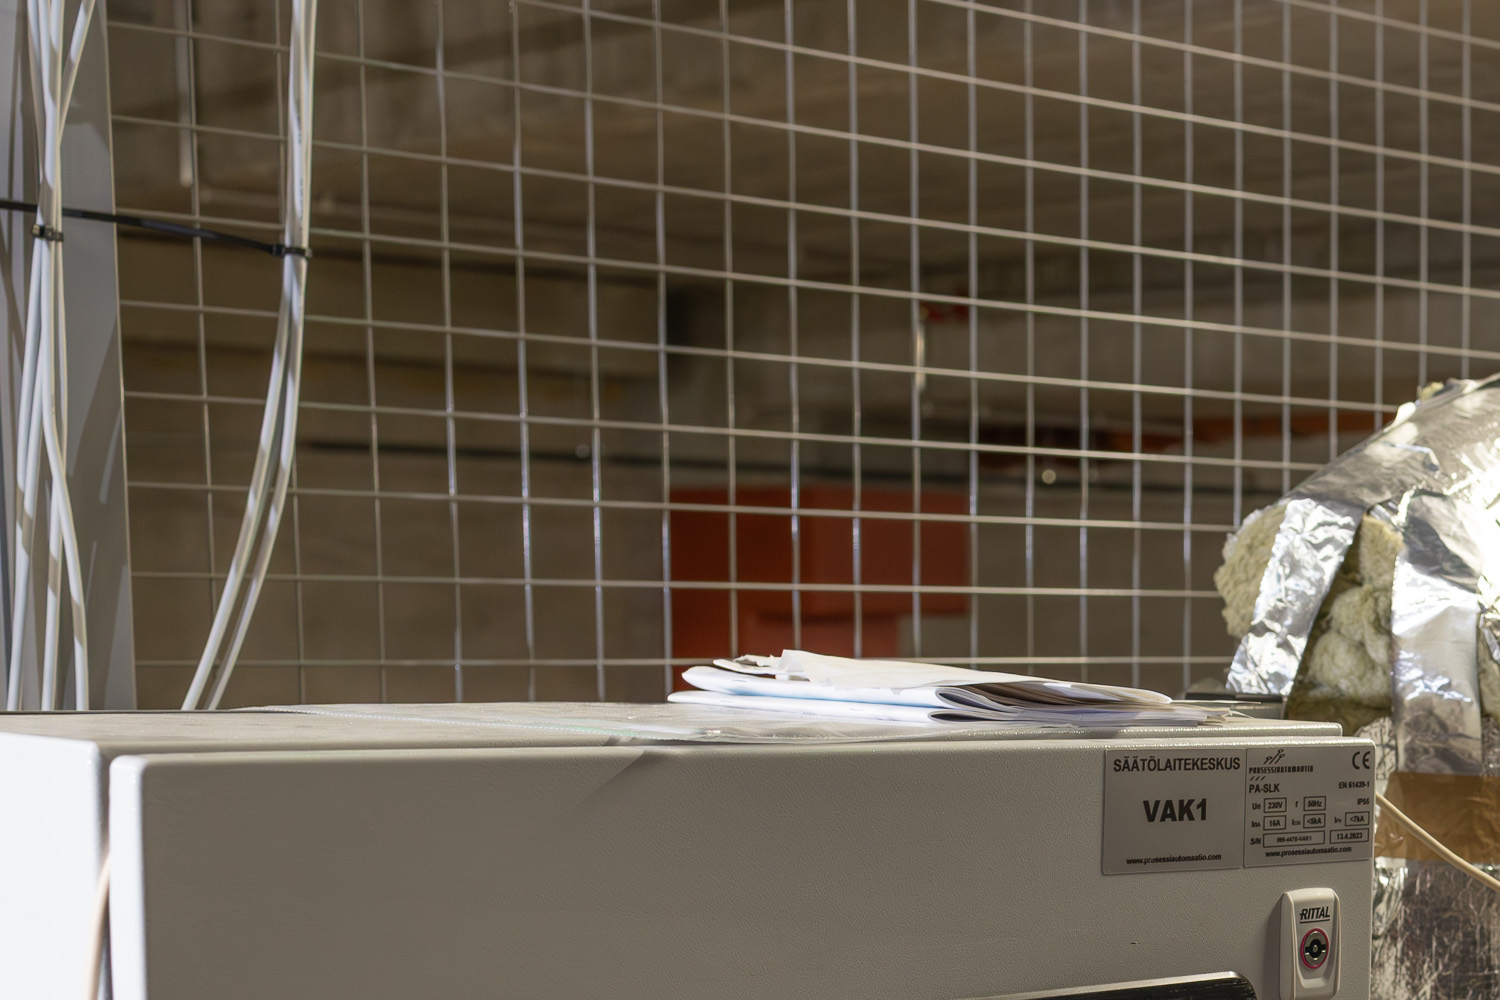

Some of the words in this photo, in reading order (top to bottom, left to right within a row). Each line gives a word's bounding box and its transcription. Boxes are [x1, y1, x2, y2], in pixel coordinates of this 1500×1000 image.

[1113, 756, 1240, 772] SÄÄTÖLAITEKESKUS
[1249, 783, 1280, 793] PA-SLK
[1308, 800, 1322, 808] 50Hz
[1143, 798, 1207, 823] VAK1
[1337, 832, 1363, 840] 13.4.2023
[1265, 846, 1352, 857] www.prosessiautomaatio.com
[1126, 854, 1221, 865] www.prosessiautomaatio.com
[1299, 906, 1330, 920] RITTAL
